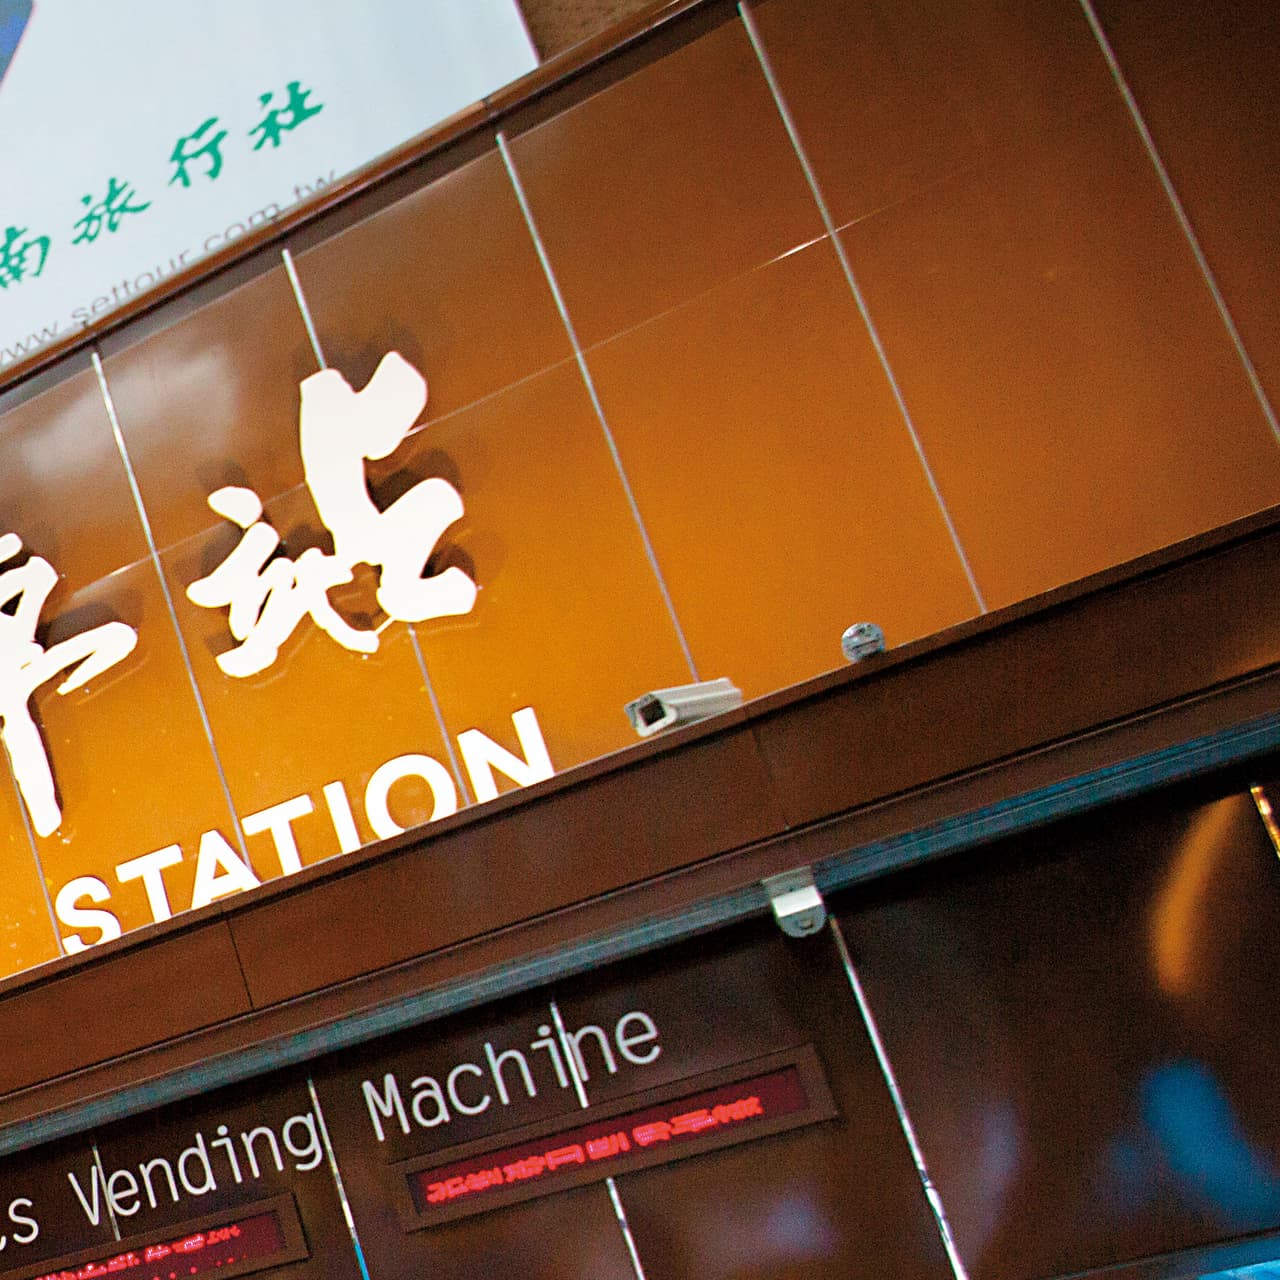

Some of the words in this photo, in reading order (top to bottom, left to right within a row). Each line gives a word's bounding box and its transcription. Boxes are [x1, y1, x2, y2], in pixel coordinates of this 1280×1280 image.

[55, 706, 558, 956] STATION
[68, 1112, 329, 1227] Vending
[360, 1008, 663, 1142] Machine
